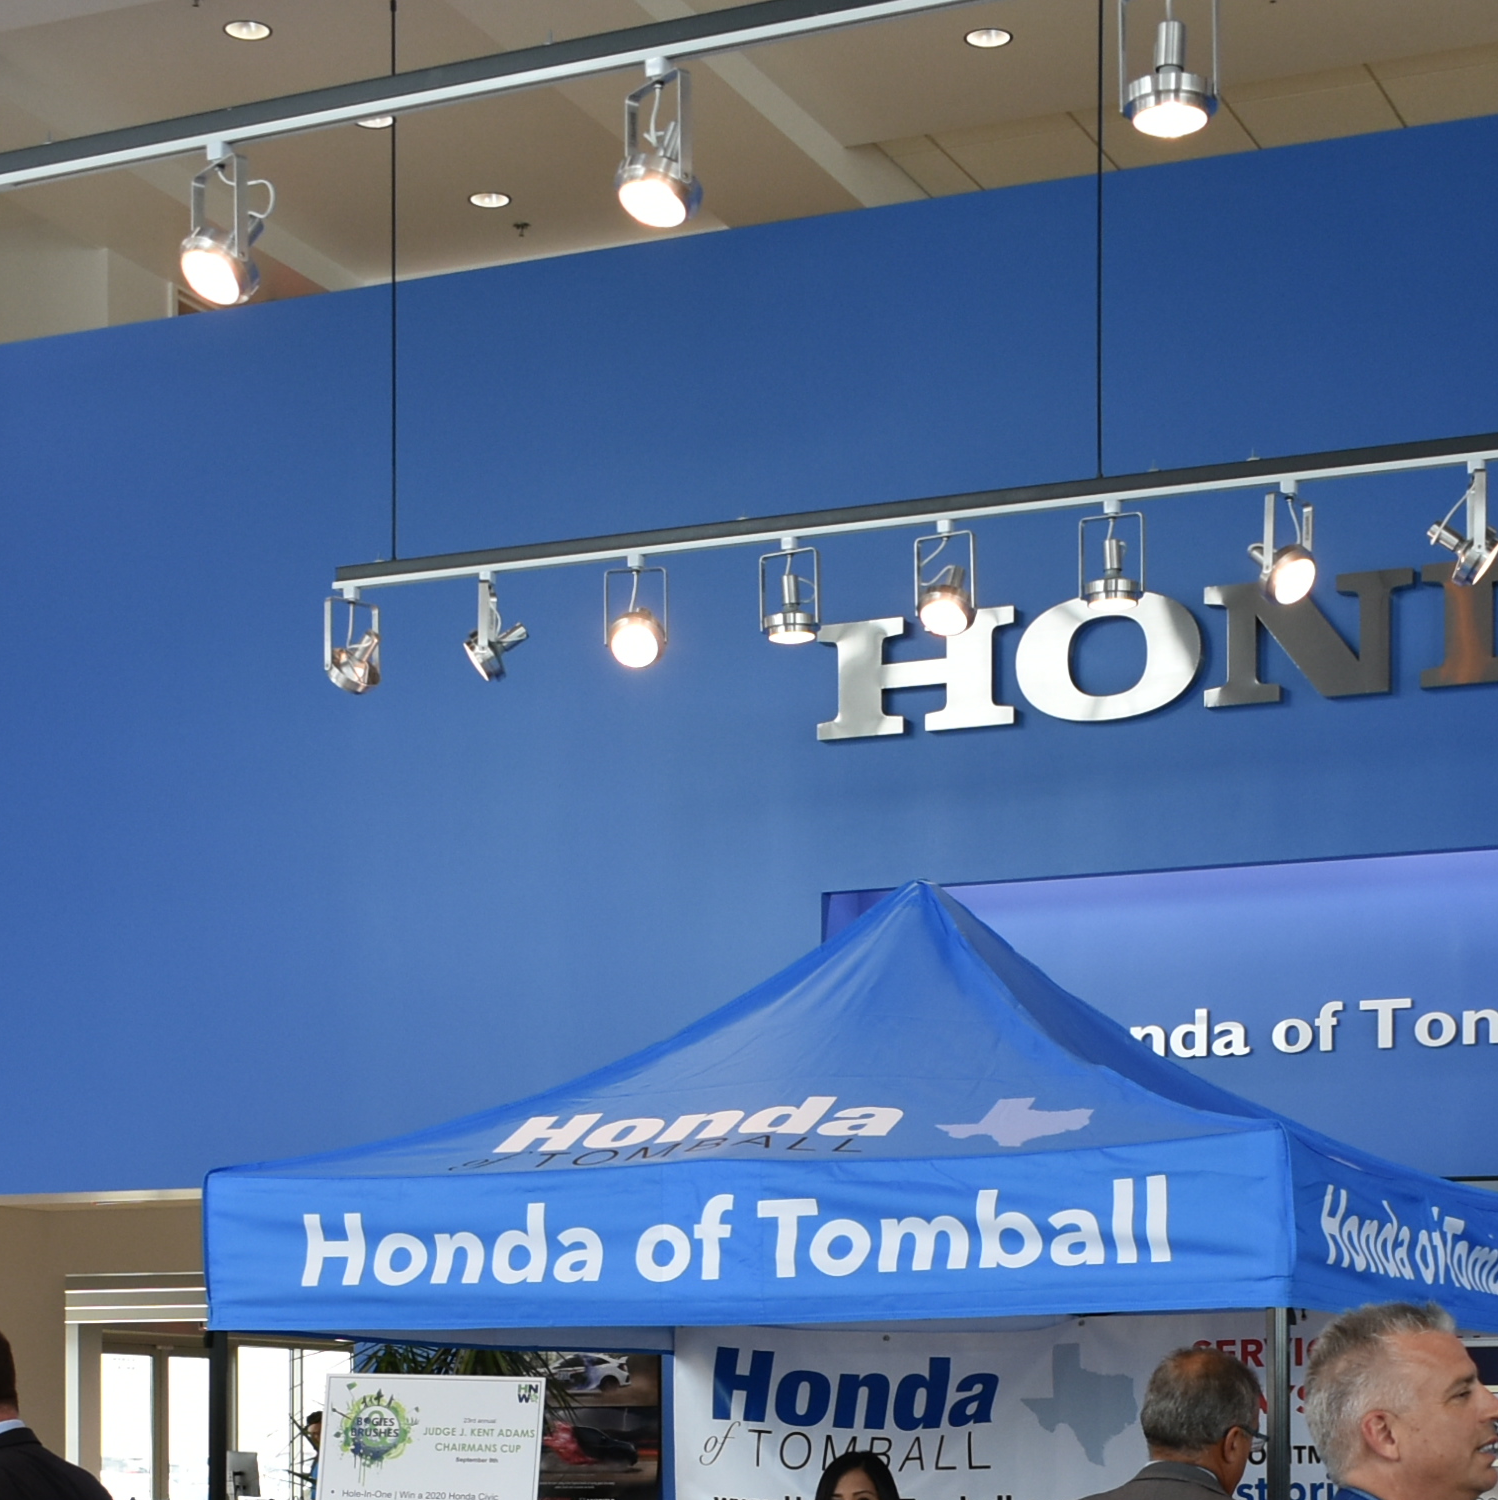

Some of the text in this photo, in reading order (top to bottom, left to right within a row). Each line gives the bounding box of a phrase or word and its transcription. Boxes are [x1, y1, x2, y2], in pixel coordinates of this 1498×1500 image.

[1130, 1008, 1250, 1058] nda
[1272, 1001, 1343, 1053] of
[493, 1096, 904, 1153] Honda
[529, 1134, 862, 1168] TOMBALL
[301, 1175, 1172, 1288] Honda of Tomball
[1321, 1184, 1415, 1280] Honda
[712, 1346, 999, 1431] Honda
[351, 1428, 399, 1437] BRUSHES
[423, 1427, 535, 1438] JUDGE J. KENT ADAMS
[434, 1442, 521, 1453] CHAIRMANS CUP
[699, 1420, 741, 1466] of
[341, 1489, 393, 1499] Hole-In-One
[399, 1491, 416, 1500] Win
[425, 1491, 446, 1500] 2020
[448, 1492, 476, 1500] Honda
[477, 1493, 499, 1500] Civic
